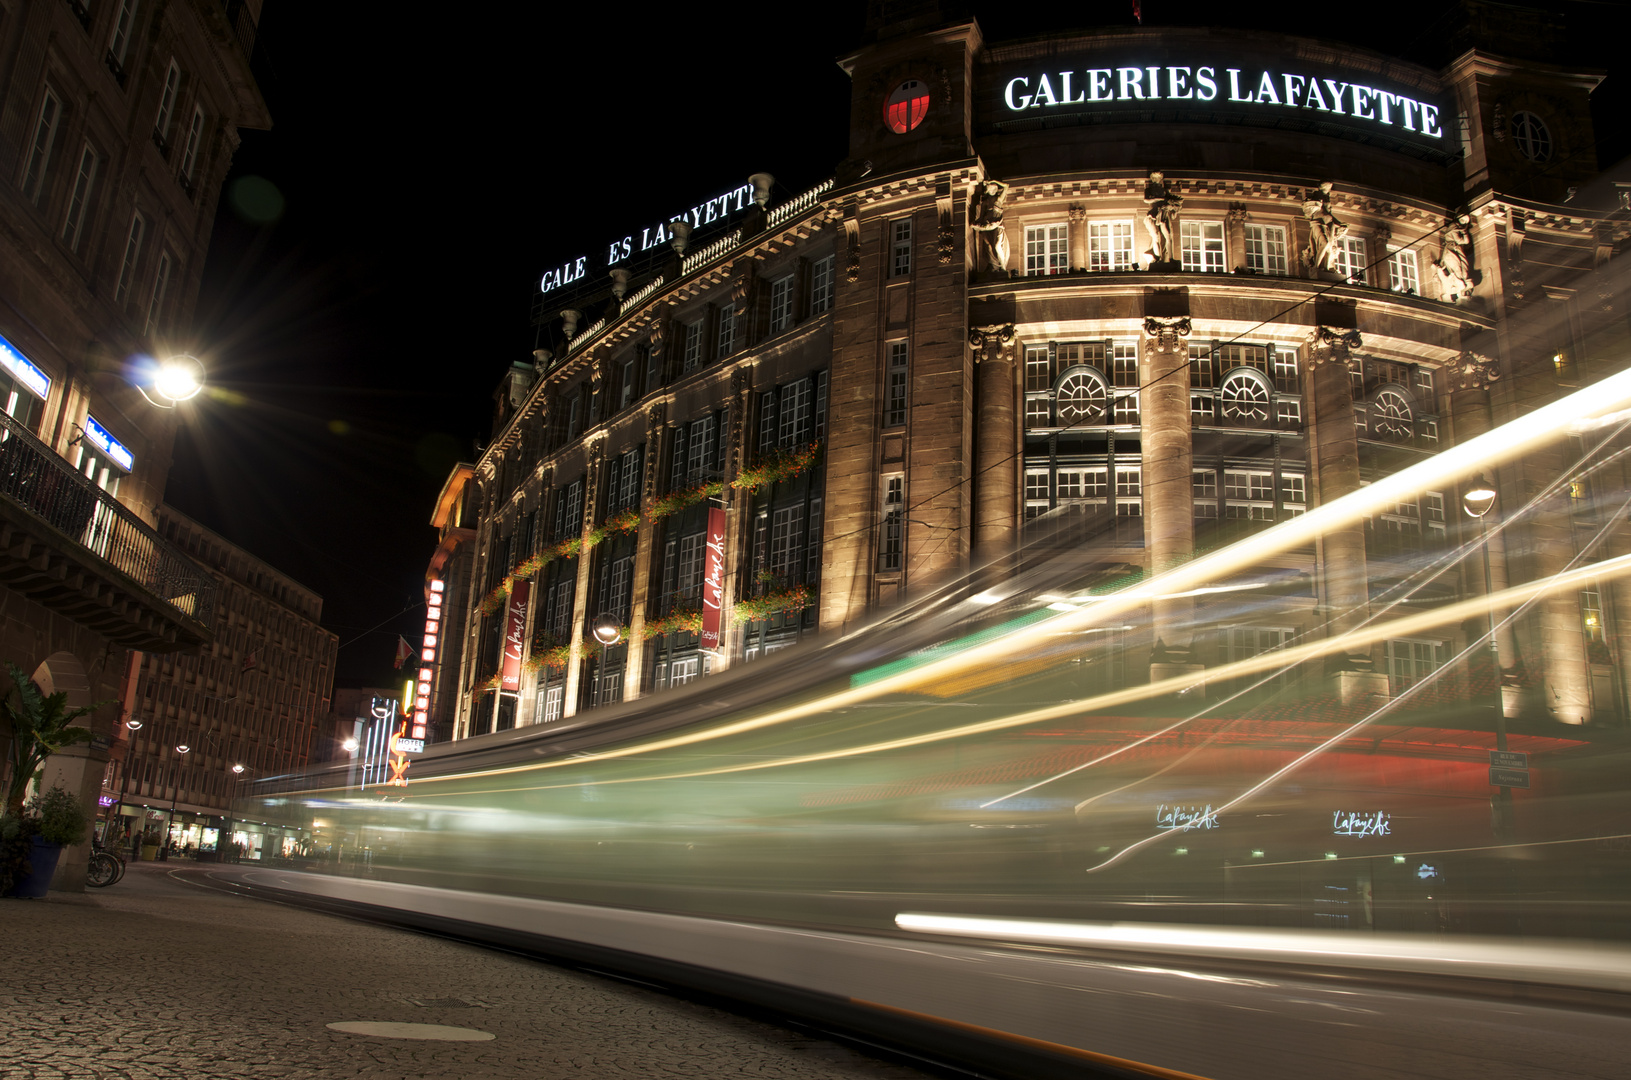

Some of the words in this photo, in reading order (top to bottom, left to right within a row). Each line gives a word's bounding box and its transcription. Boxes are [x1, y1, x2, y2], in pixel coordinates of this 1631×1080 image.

[1004, 66, 1218, 111] GALERIES
[1227, 69, 1442, 139] LAFAYETTE
[540, 236, 632, 293] GALEES
[398, 739, 424, 748] HOTEL
[1333, 810, 1391, 839] Lafayette
